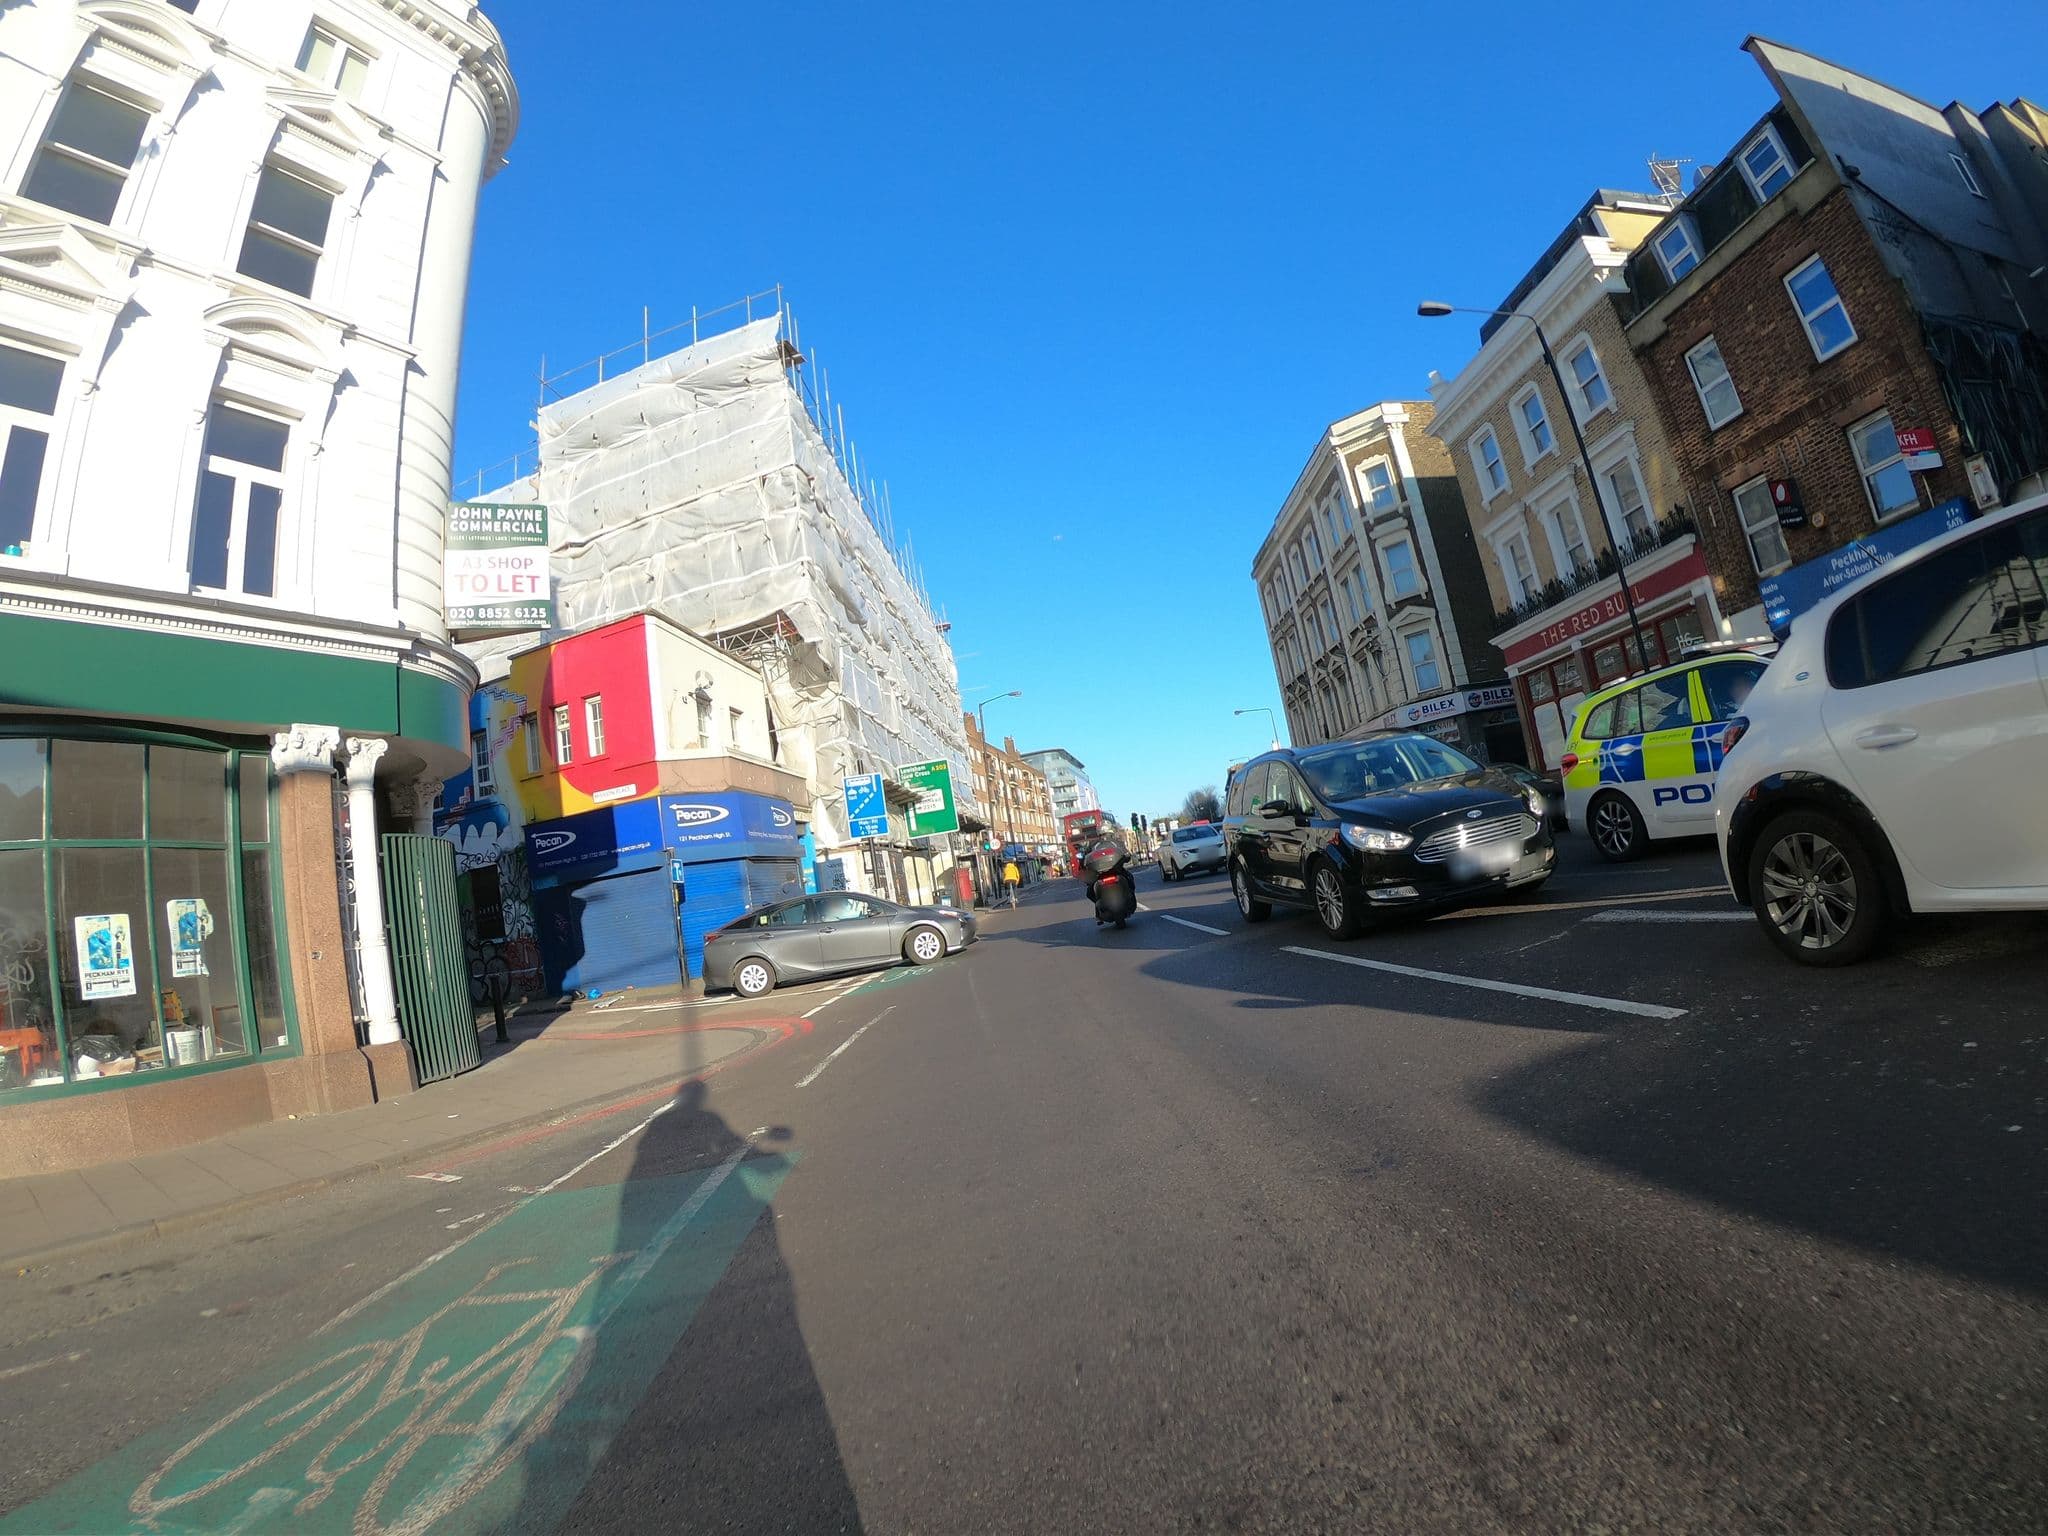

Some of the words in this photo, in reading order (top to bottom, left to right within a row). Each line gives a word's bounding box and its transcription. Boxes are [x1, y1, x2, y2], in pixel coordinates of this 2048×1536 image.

[1897, 433, 1918, 446] KFH
[450, 507, 492, 520] JOHN
[497, 508, 543, 522] PAYNE
[450, 521, 543, 534] COMMERCIAL
[462, 556, 482, 569] A3
[488, 556, 534, 570] SHOP
[1831, 544, 1877, 571] Peckham
[453, 574, 489, 593] TO
[497, 574, 541, 593] LET
[450, 607, 475, 619] 020
[478, 607, 511, 619] 8852
[514, 607, 547, 619] 6125
[1540, 622, 1569, 648] THE
[1571, 608, 1600, 633] RED
[1605, 587, 1646, 617] BUL
[1482, 687, 1515, 701] BILEX
[1422, 699, 1455, 714] BILEX
[900, 766, 926, 775] Lewisham
[676, 809, 712, 822] Pecan
[535, 835, 562, 849] Pecan
[688, 833, 713, 841] Peckham
[713, 832, 725, 840] High
[85, 969, 115, 979] PECKHAM
